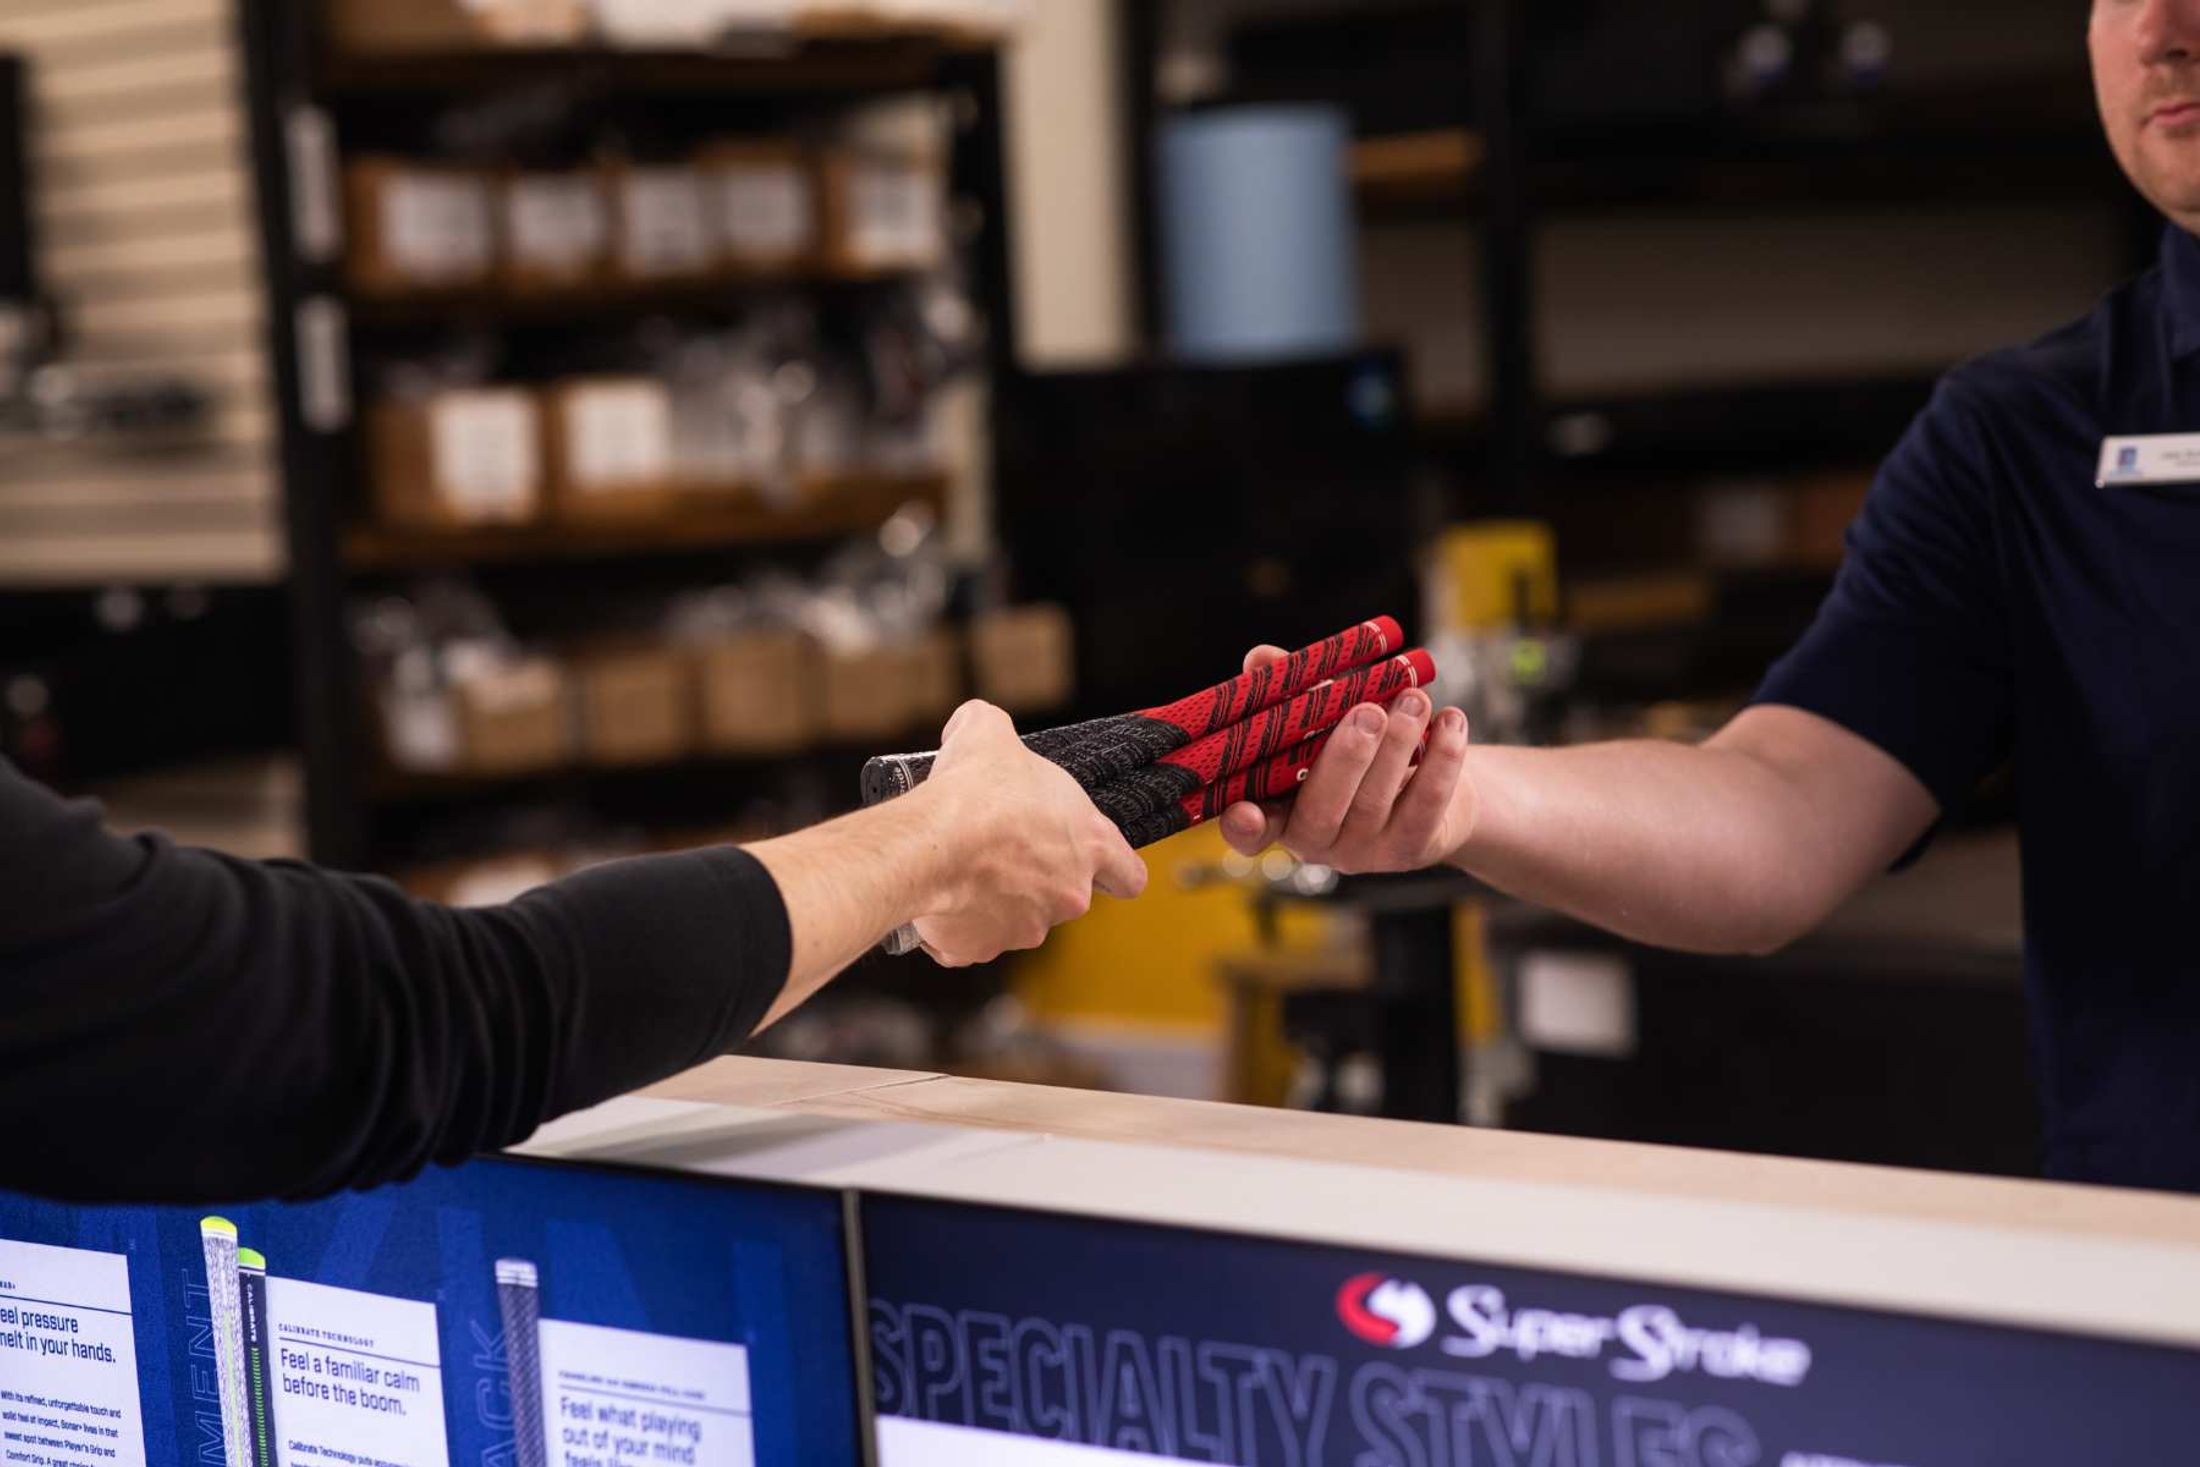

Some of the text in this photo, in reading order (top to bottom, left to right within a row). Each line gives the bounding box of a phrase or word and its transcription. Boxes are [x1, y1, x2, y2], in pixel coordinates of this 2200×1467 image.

[21, 1311, 79, 1333] pressure
[25, 1332, 38, 1351] in
[40, 1337, 69, 1356] your
[71, 1338, 116, 1363] hands.
[280, 1348, 420, 1393] Feel a familiar calm
[282, 1373, 407, 1416] before the boom.
[561, 1396, 701, 1443] Feel what playing
[562, 1427, 588, 1446] out
[593, 1430, 609, 1449] of
[614, 1436, 649, 1458] your
[654, 1442, 696, 1466] mind
